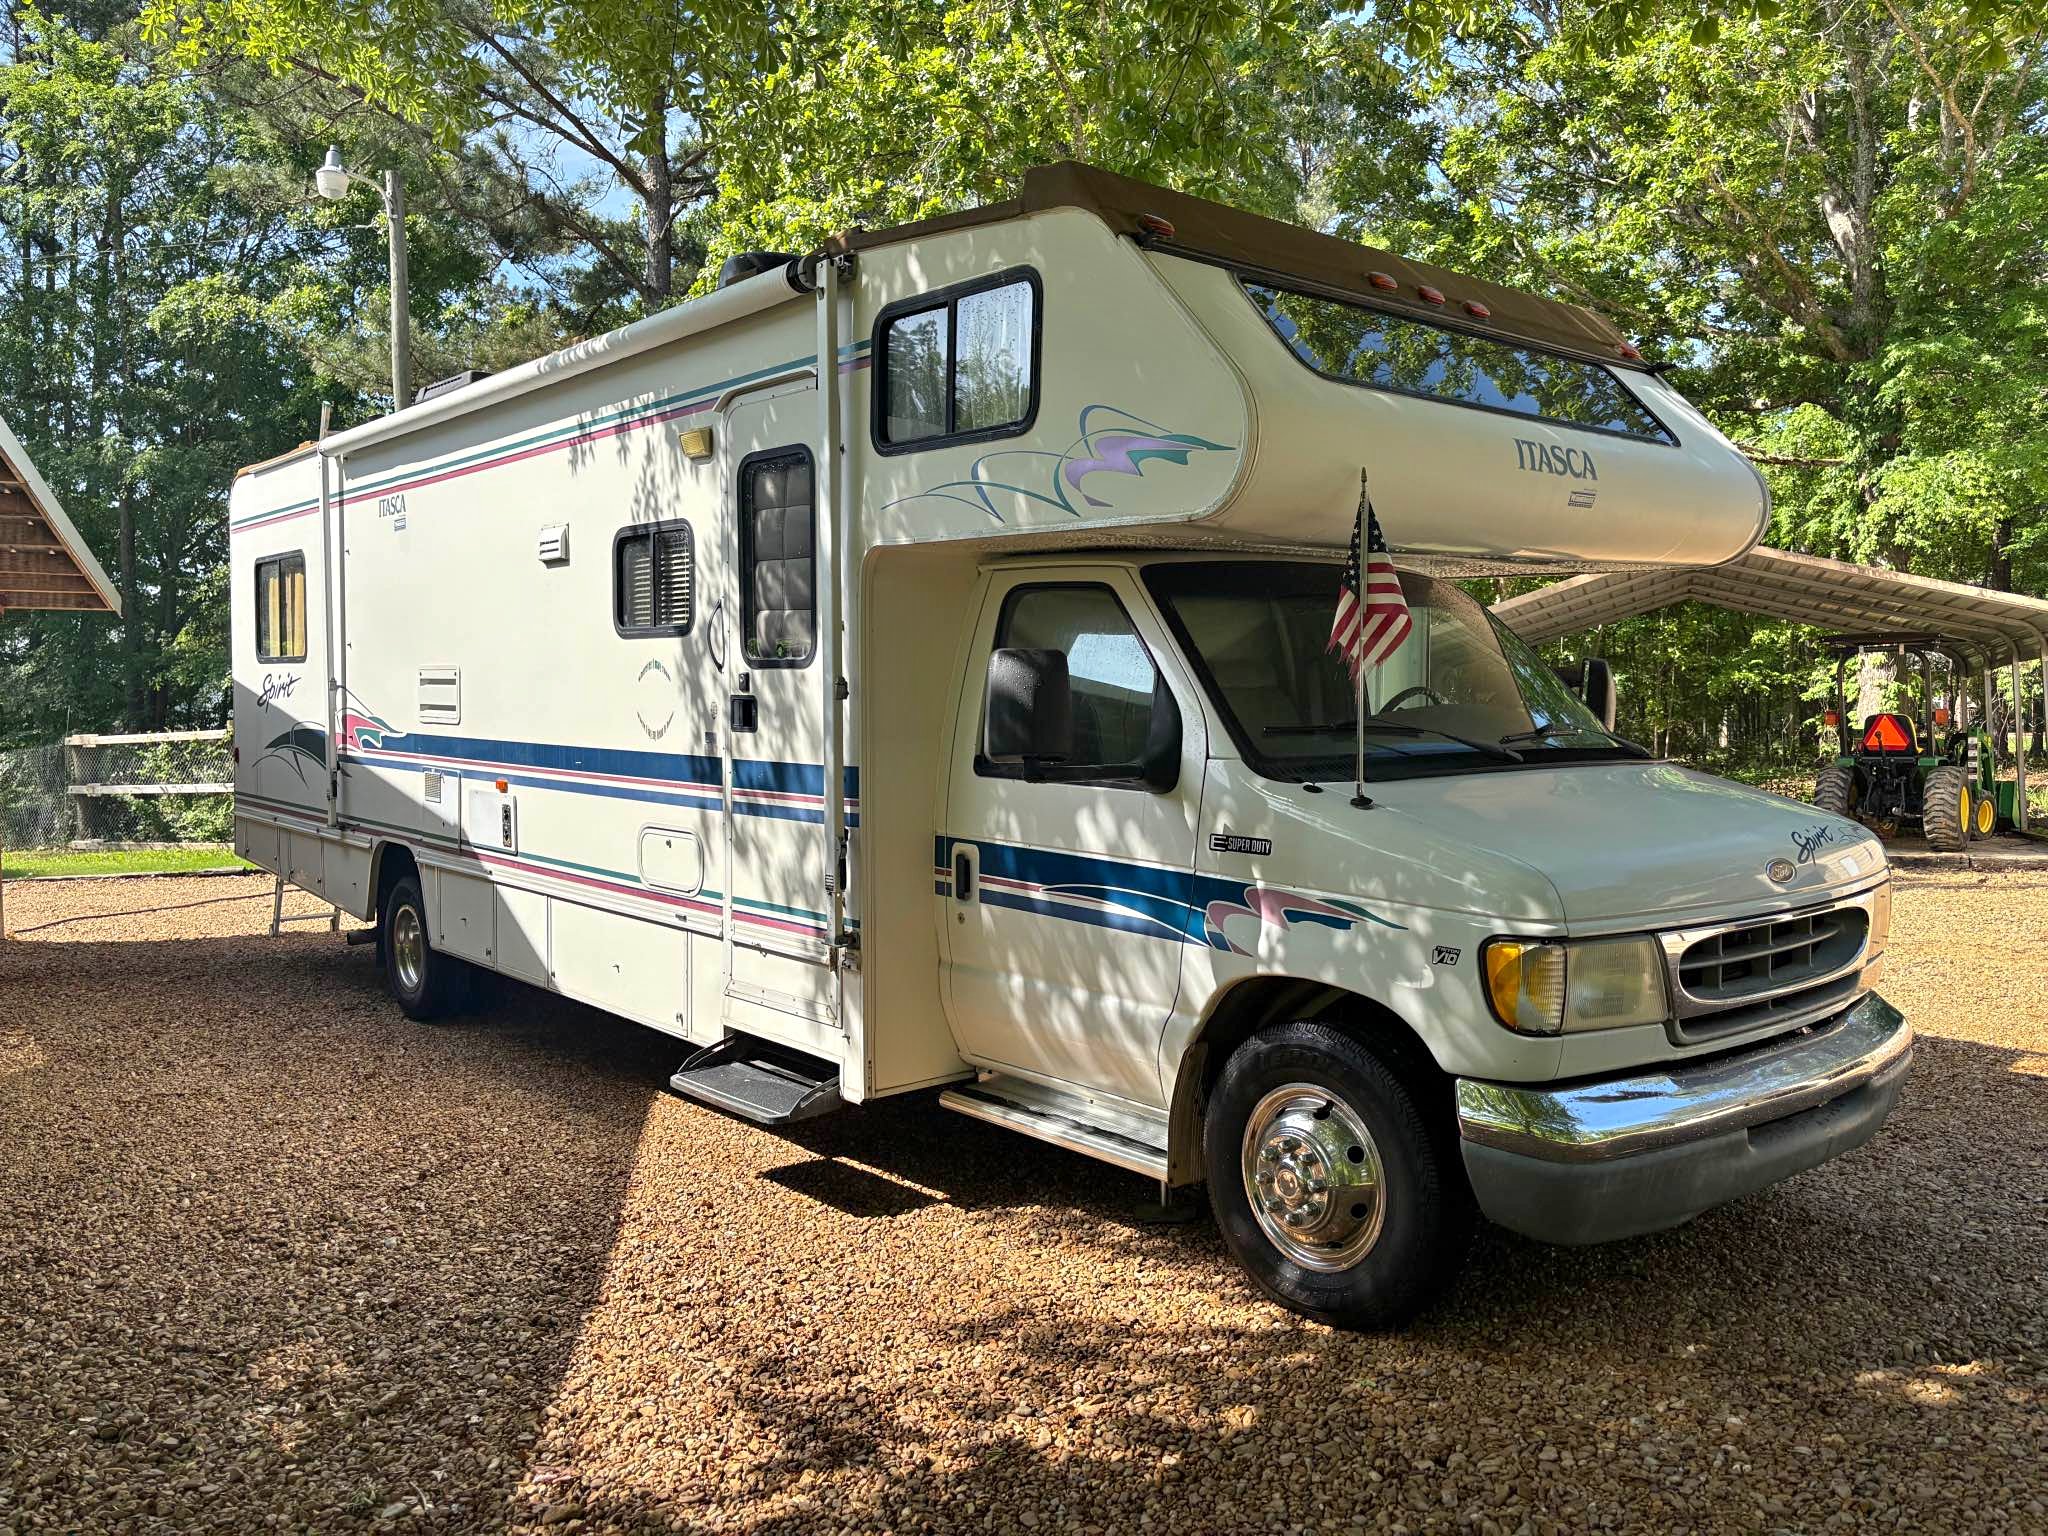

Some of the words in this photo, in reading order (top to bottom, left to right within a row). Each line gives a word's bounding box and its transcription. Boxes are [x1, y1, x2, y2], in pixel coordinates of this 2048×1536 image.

[1512, 437, 1599, 481] ITASCA
[378, 493, 407, 518] ITASCA
[257, 672, 302, 713] Spirit
[1251, 839, 1271, 854] DUTY
[1791, 824, 1834, 866] Spirit
[1432, 948, 1459, 965] V10
